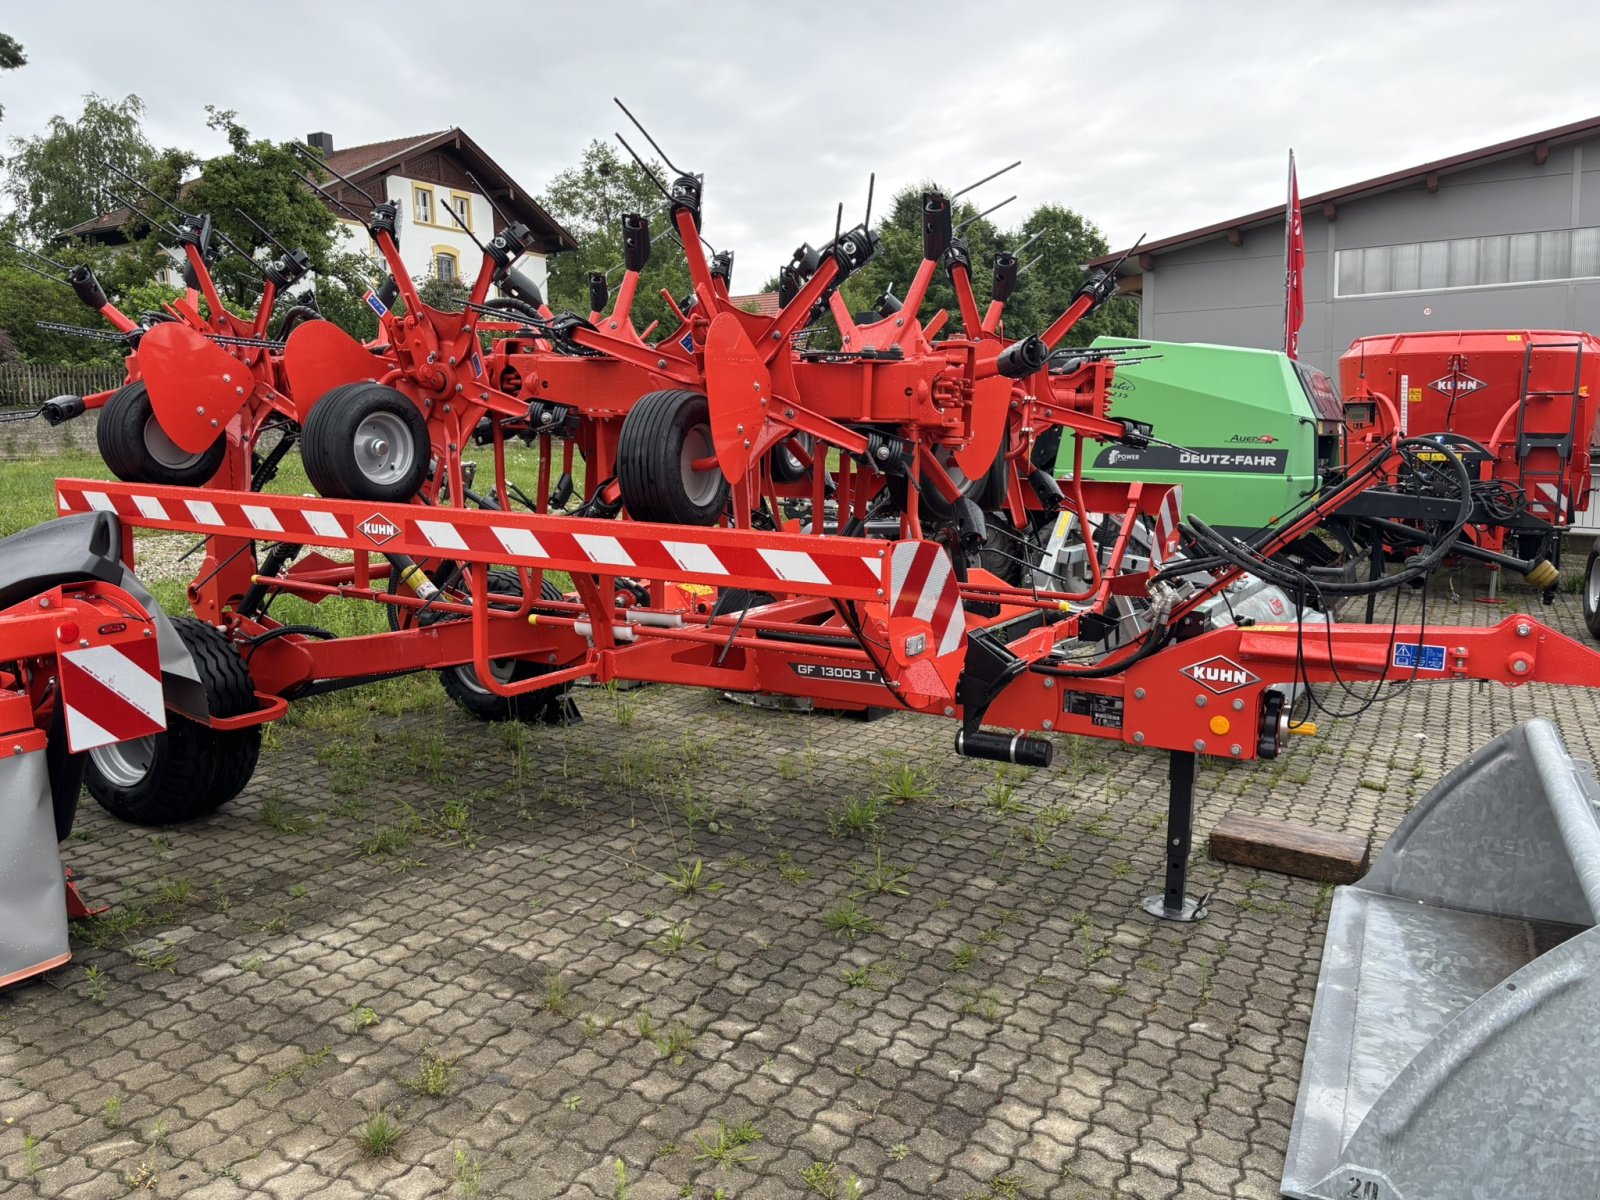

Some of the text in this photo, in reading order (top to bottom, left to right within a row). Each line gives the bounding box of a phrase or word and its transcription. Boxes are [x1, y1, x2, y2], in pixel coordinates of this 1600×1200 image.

[1179, 453, 1277, 467] DEUTZ-FAHR
[363, 522, 394, 536] KUHN
[797, 664, 815, 674] GF
[821, 667, 861, 679] 13003
[866, 671, 876, 680] T
[1193, 666, 1247, 684] KUHN
